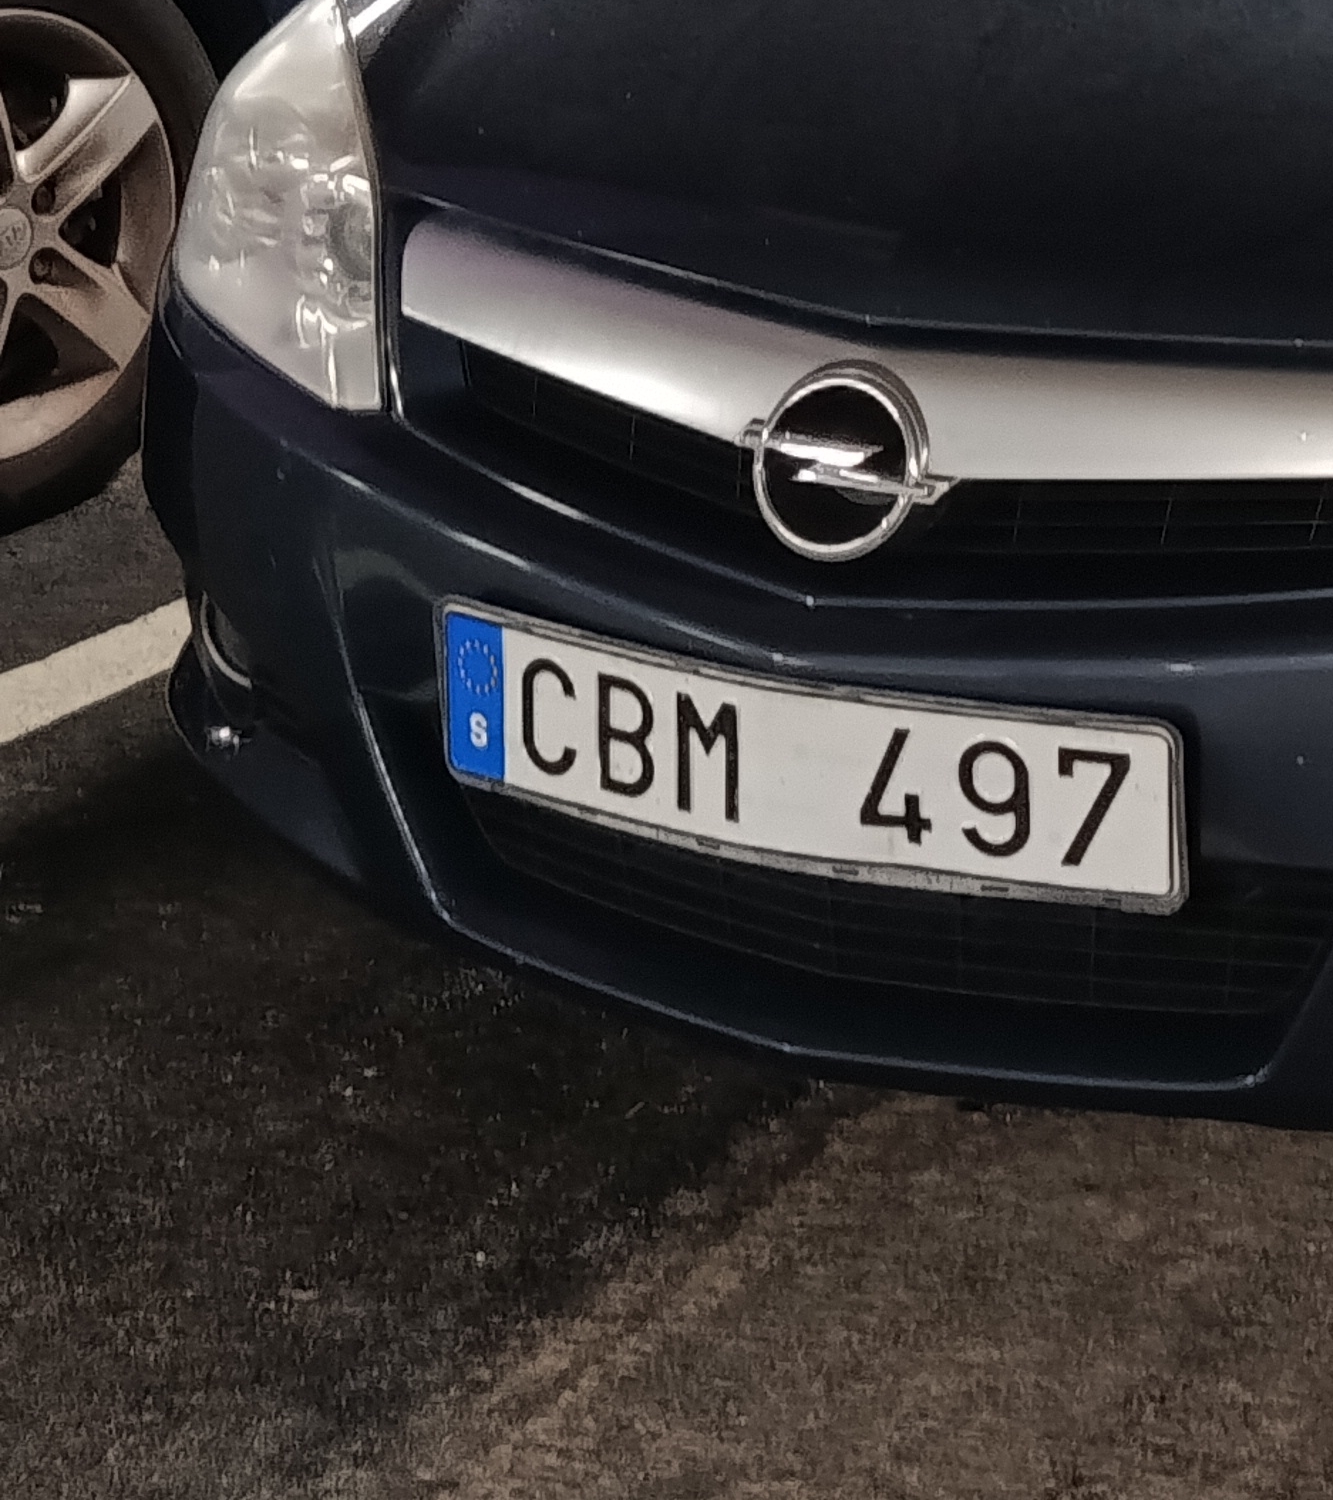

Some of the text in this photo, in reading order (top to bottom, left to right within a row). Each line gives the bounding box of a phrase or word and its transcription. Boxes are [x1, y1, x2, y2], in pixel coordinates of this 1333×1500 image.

[469, 711, 488, 749] S
[521, 658, 1132, 867] CBM 497
